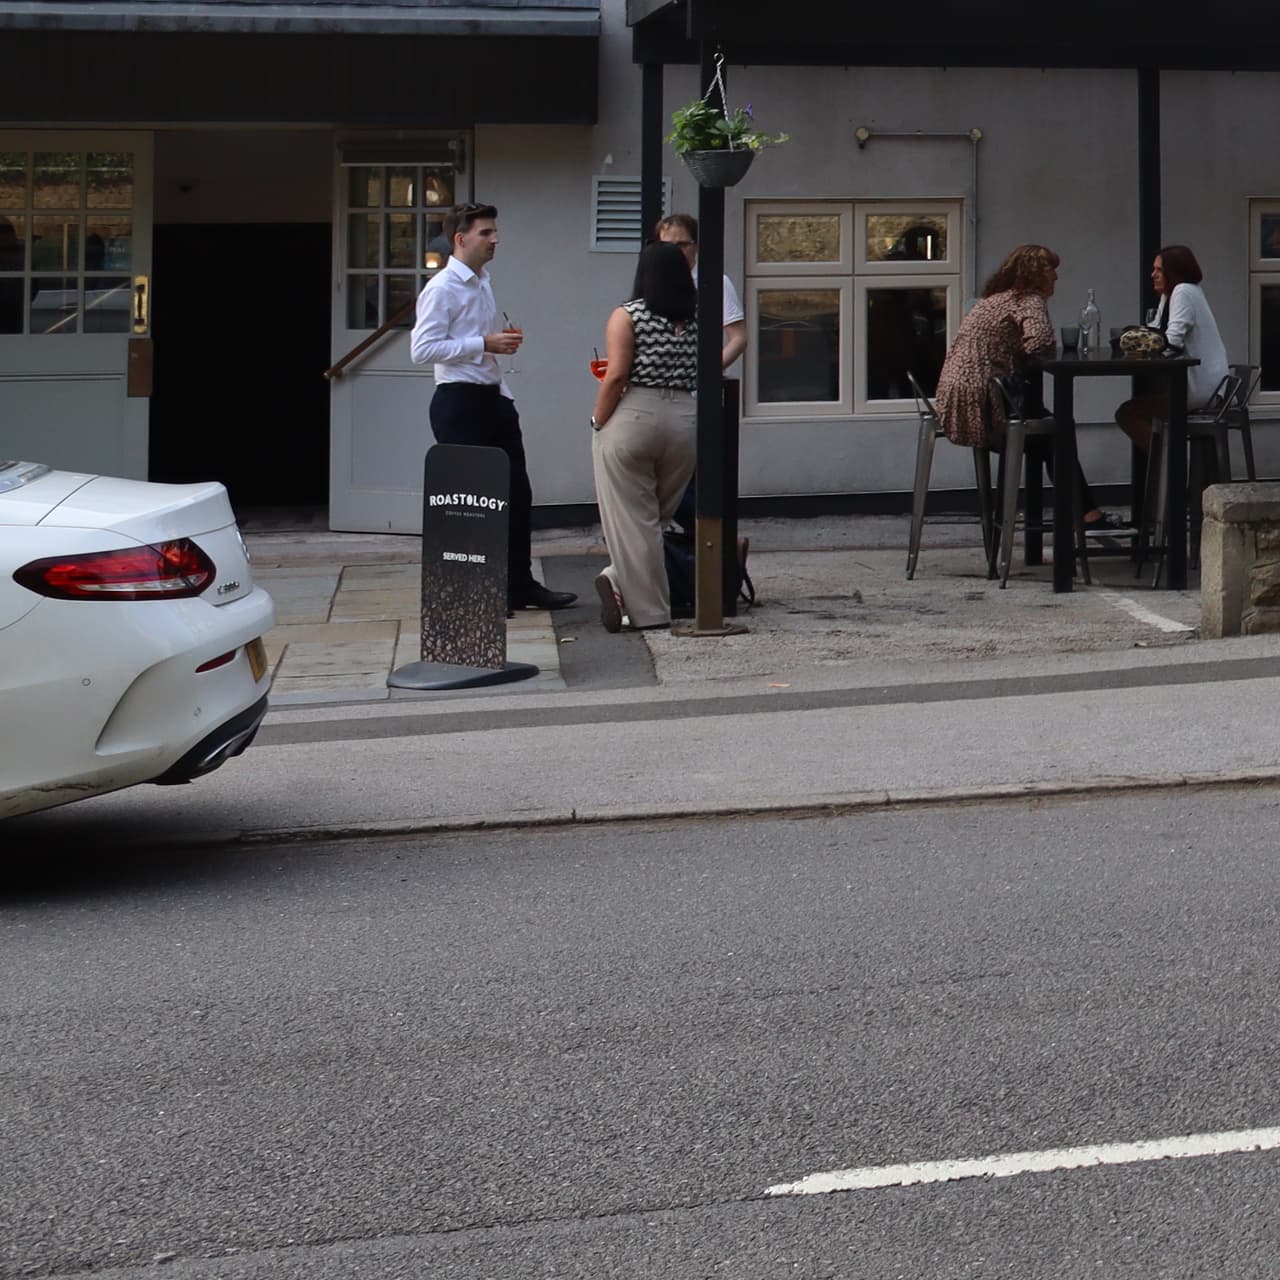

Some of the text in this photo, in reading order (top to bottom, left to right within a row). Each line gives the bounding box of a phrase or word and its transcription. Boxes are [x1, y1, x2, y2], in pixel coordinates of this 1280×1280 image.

[429, 493, 505, 512] ROASTOLOGY
[442, 552, 486, 564] SERVED HERE
